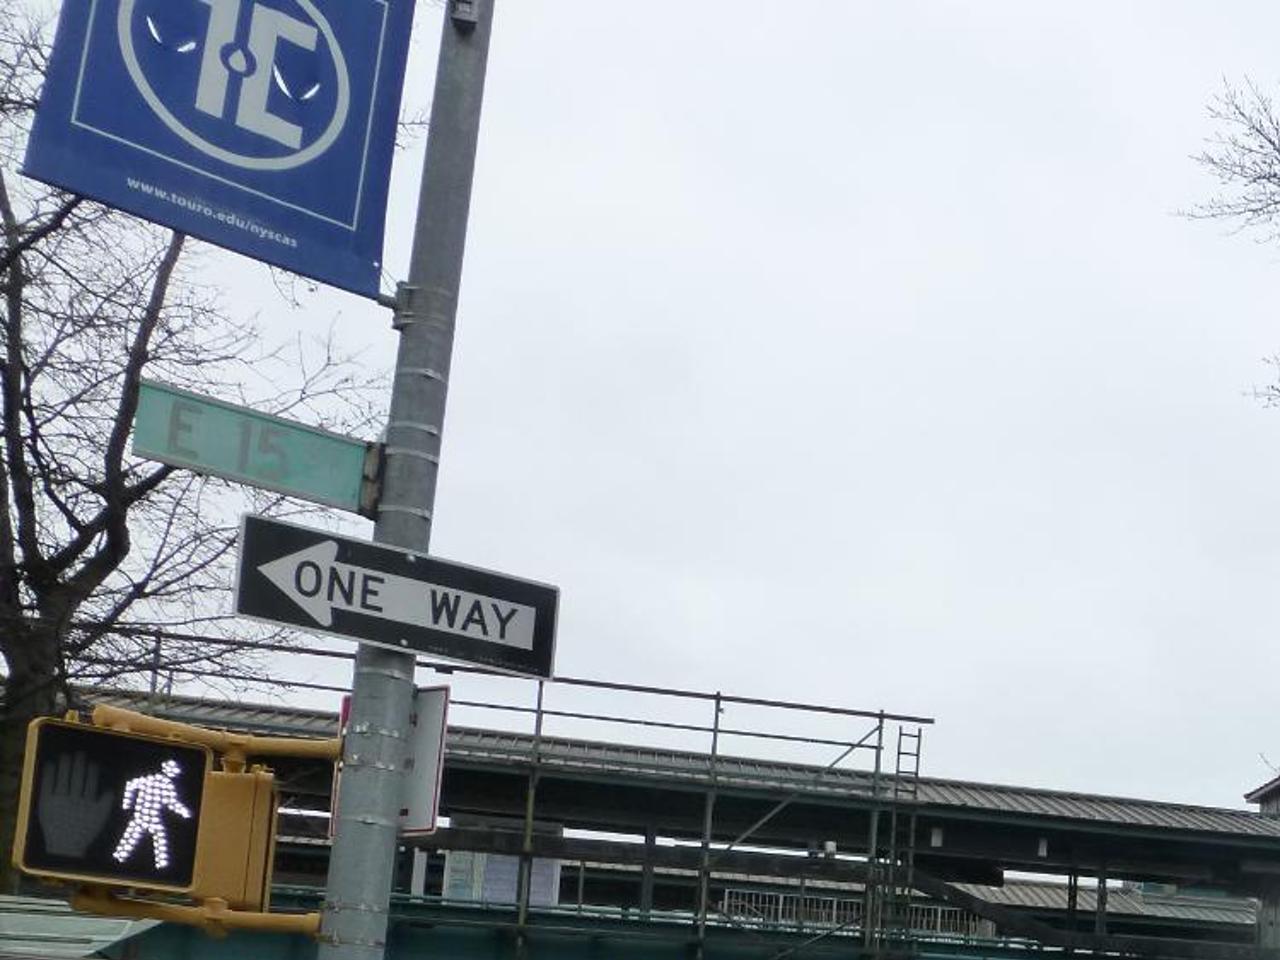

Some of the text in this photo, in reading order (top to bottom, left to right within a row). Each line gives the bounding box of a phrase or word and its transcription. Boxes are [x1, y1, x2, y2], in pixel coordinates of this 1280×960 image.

[127, 177, 297, 248] www.touro.edu/nyscas
[168, 401, 203, 460] E
[294, 560, 518, 640] ONE WAY
